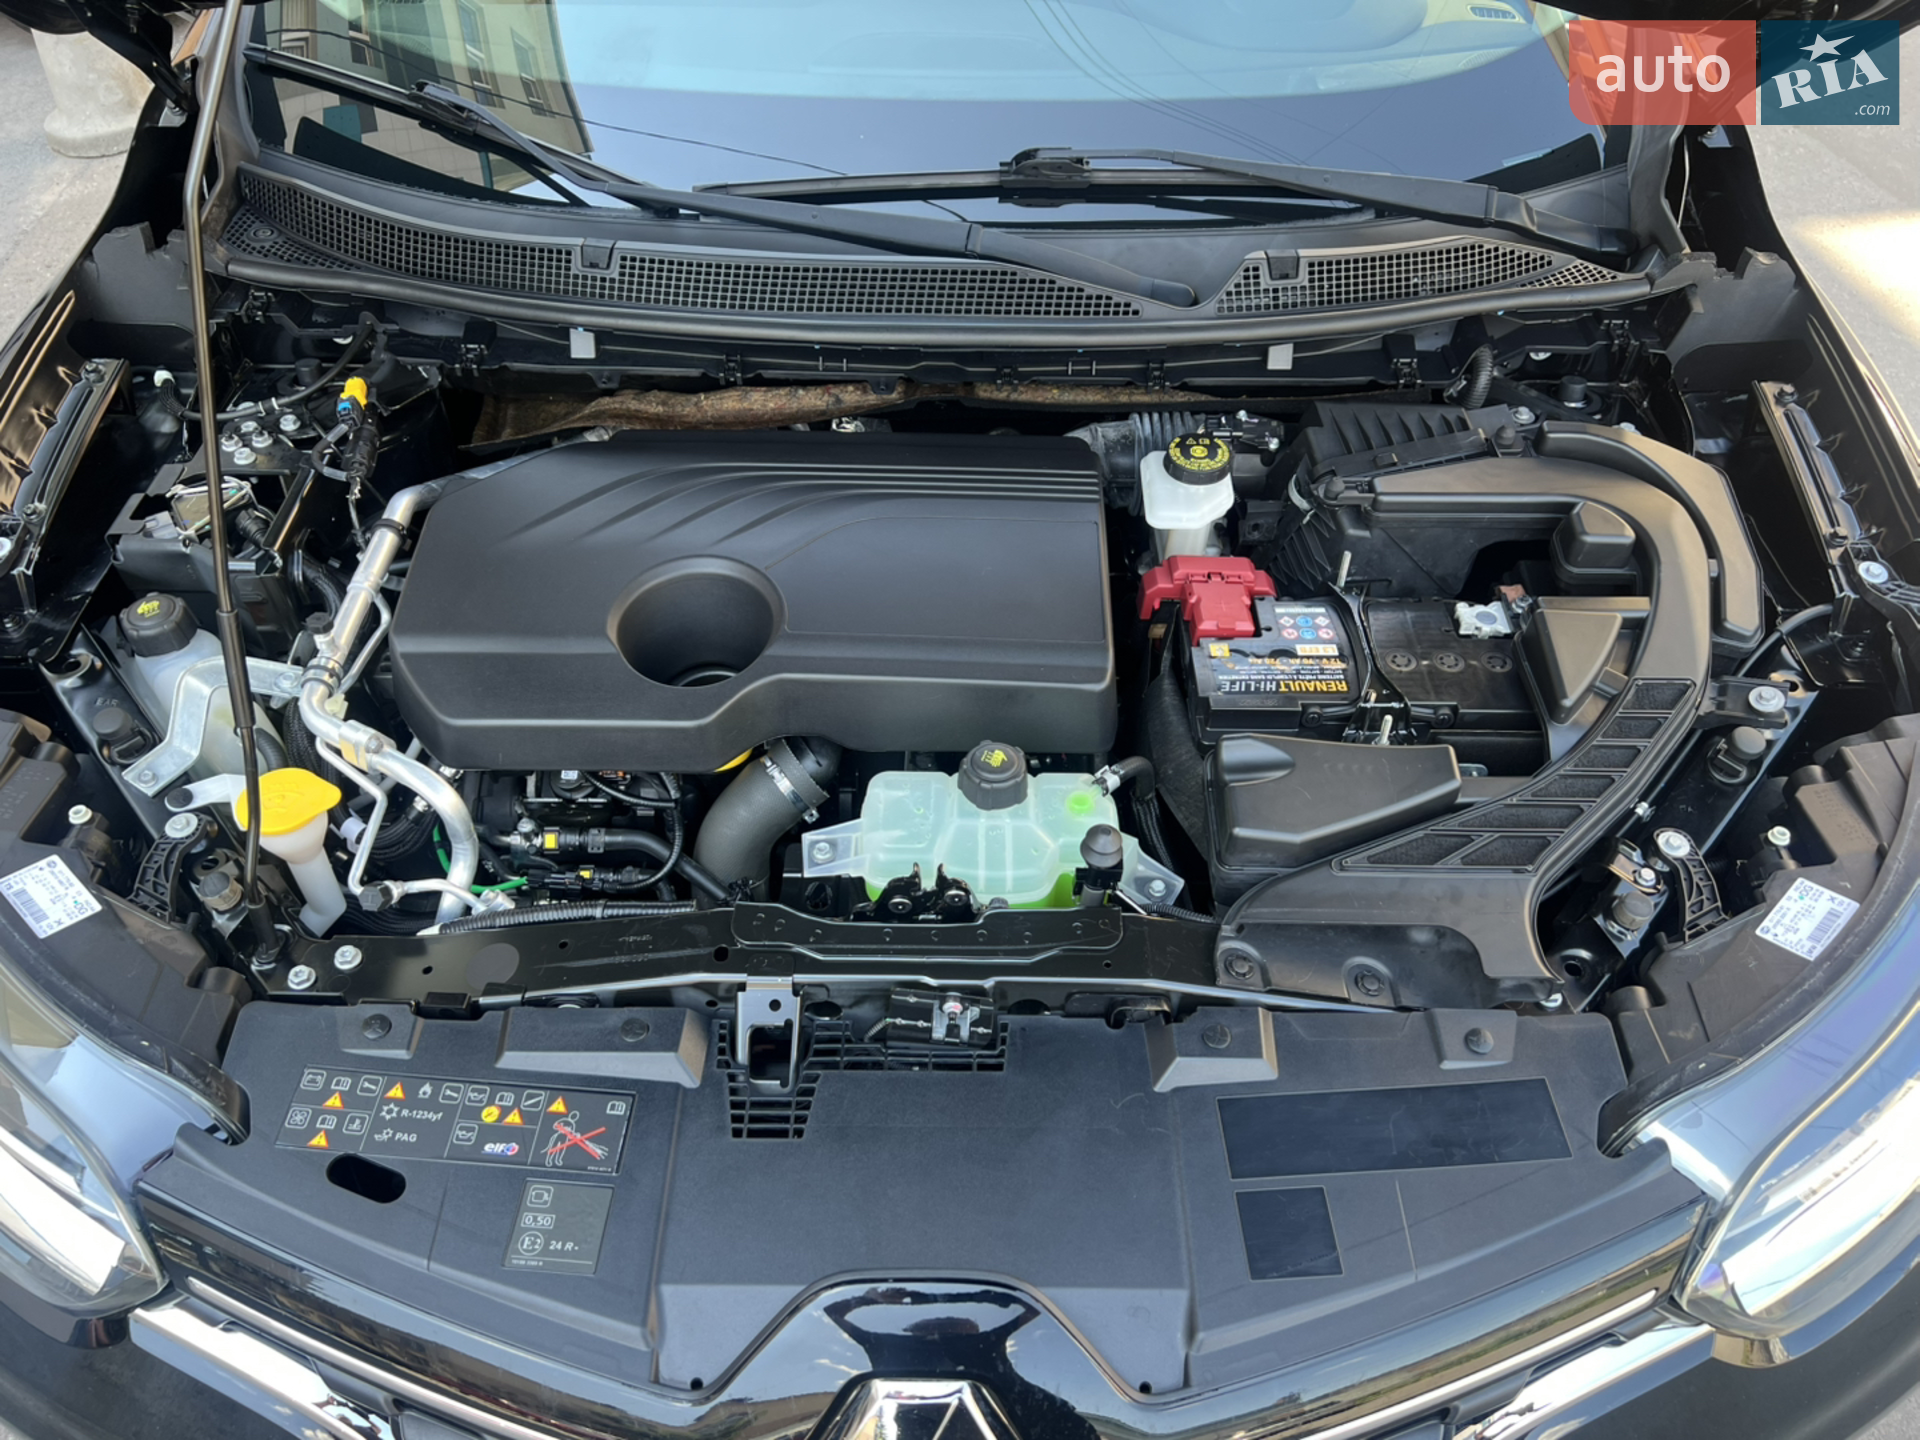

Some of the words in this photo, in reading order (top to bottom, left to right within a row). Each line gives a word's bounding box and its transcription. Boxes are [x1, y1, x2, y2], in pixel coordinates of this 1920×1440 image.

[1279, 680, 1348, 692] RENAULT
[400, 1108, 443, 1122] R-1234yf
[394, 1131, 417, 1142] PAG
[484, 1142, 507, 1153] elf
[524, 1215, 552, 1226] 0,50
[548, 1240, 562, 1251] 24
